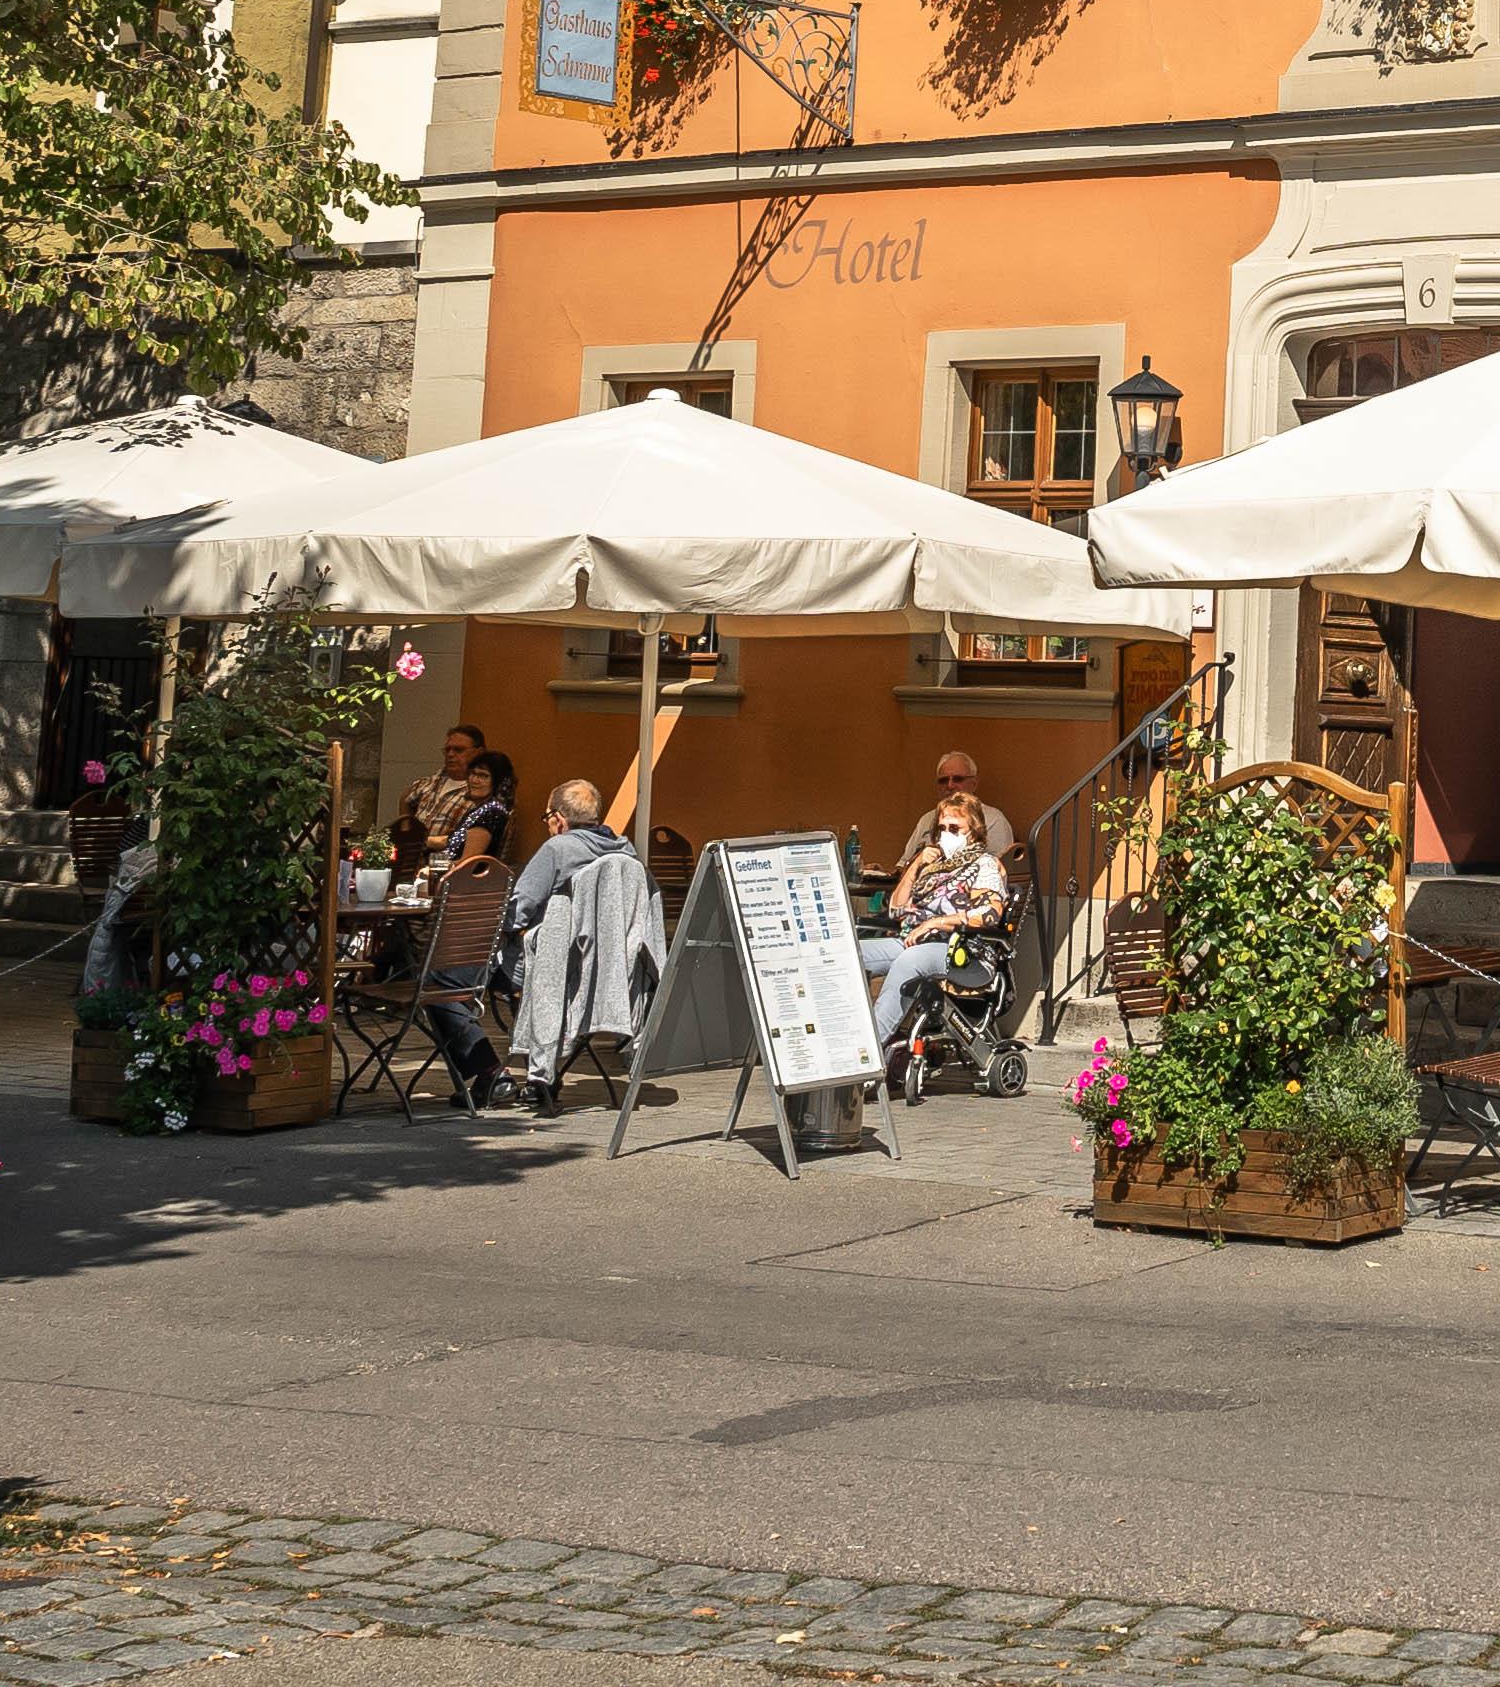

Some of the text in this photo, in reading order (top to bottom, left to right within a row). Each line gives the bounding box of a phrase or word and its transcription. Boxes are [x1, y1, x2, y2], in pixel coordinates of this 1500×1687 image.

[545, 0, 612, 39] Gasthaus
[542, 44, 612, 83] Schranne
[765, 218, 927, 289] Hotel
[1418, 277, 1436, 309] 6
[735, 858, 773, 873] Geöffnet
